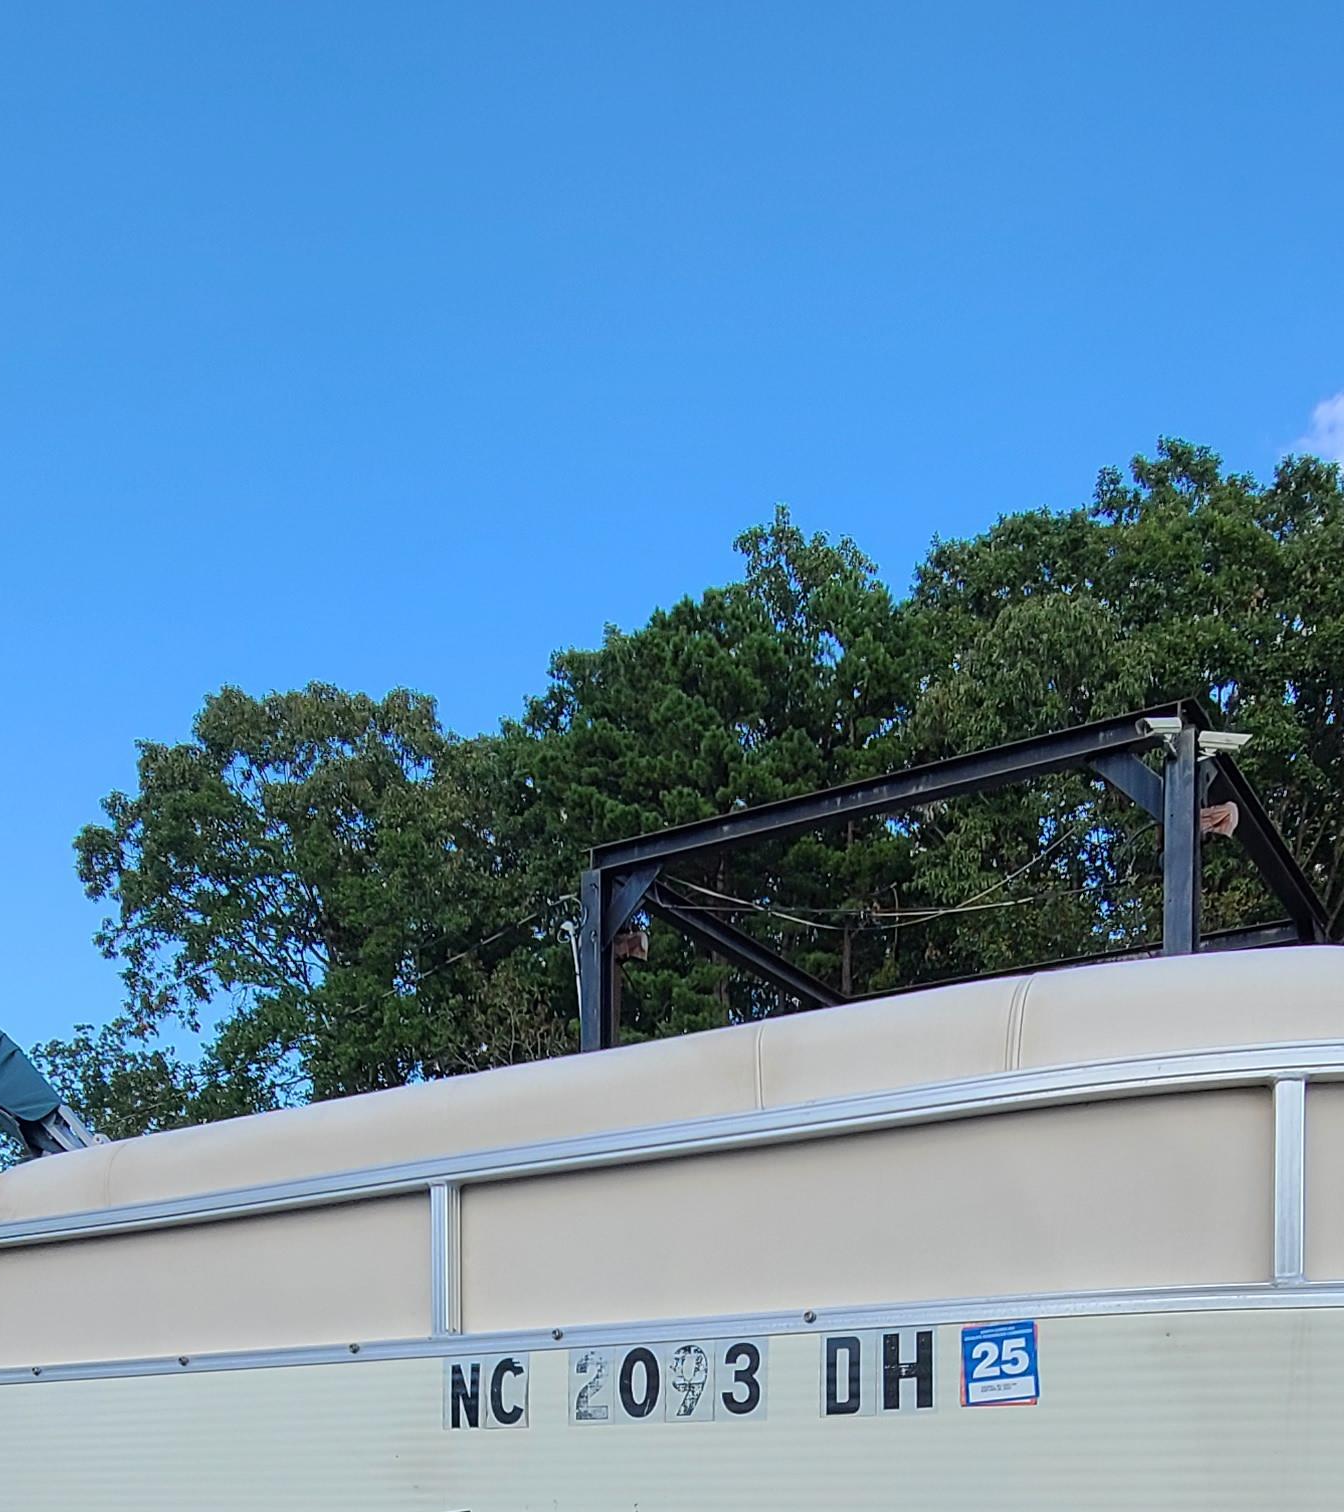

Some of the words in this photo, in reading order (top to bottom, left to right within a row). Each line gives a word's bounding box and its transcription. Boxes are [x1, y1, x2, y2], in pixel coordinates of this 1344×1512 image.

[451, 1356, 525, 1428] NC
[575, 1342, 762, 1420] 2093
[826, 1330, 934, 1415] DH
[971, 1337, 1030, 1379] 25
